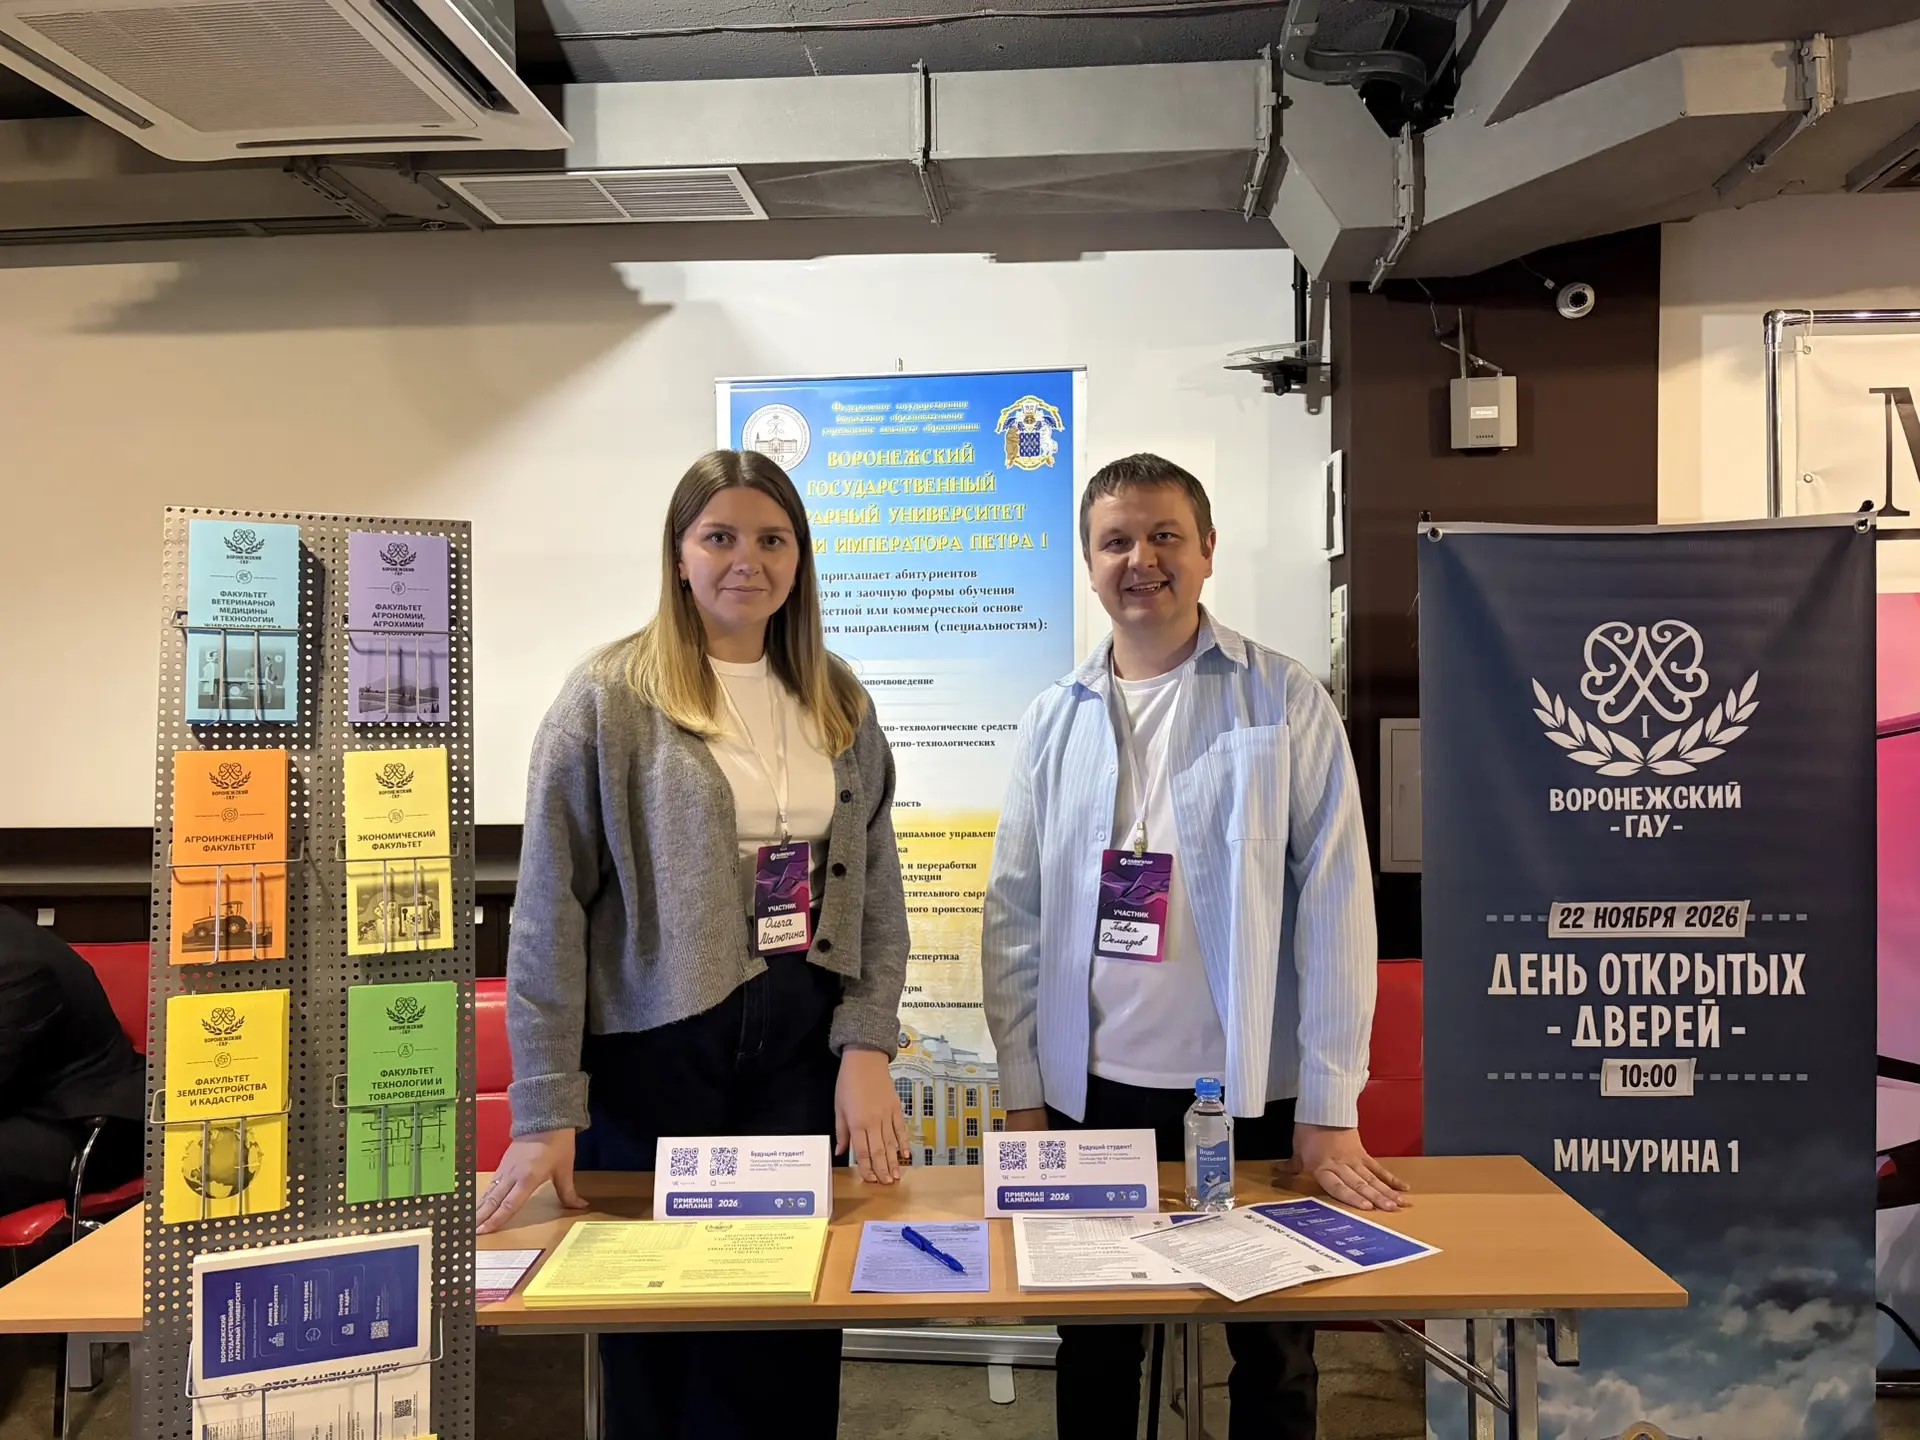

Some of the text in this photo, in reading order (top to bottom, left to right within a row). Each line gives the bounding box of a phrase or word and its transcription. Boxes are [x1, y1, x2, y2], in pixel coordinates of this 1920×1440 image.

[827, 444, 975, 468] ВОРОНЕЖСКИЙ
[807, 472, 996, 498] ГОСУДАРСТВЕННЫЙ
[888, 503, 1027, 525] УНИВЕРСИТЕТ
[835, 534, 962, 553] ИМПЕРАТОРА
[970, 533, 1034, 550] ПЕТРА
[1040, 532, 1048, 549] I
[821, 568, 977, 583] приглашает абитуриентов
[220, 590, 267, 598] ФАКУЛЬТЕТ
[845, 590, 852, 598] и
[857, 588, 907, 600] заочную
[911, 586, 955, 599] формы
[959, 585, 1015, 597] обучения
[211, 598, 276, 607] ВЕТЕРИНАРНОЙ
[375, 603, 422, 611] ФАКУЛЬТЕТ
[219, 607, 268, 615] МЕДИЦИНЫ
[866, 605, 890, 615] или
[893, 602, 979, 617] коммерческой
[983, 603, 1024, 614] основе
[220, 615, 274, 623] ТЕХНОЛОГИИ
[372, 612, 425, 620] АГРОНОМИИ,
[373, 620, 424, 629] АГРОХИМИИ
[845, 622, 929, 635] направлениям
[934, 618, 1048, 635] (специальностям):
[1549, 782, 1742, 812] ВОРОНЕЖСКИЙ
[184, 832, 274, 843] АГРОИНЖЕНЕРНЫЙ
[357, 829, 436, 842] ЭКОНОМИЧЕСКИЙ
[202, 843, 256, 852] ФАКУЛЬТЕТ
[371, 840, 422, 850] ФАКУЛЬТЕТ
[917, 861, 977, 872] переработки
[768, 903, 797, 912] УЧАСТНИК
[1113, 909, 1149, 918] УЧАСТНИК
[765, 918, 793, 929] Ольга
[1558, 905, 1739, 930] 22 НОЯБРЯ 2026
[1487, 952, 1807, 996] ДЕНЬ ОТКРЫТЫХ
[901, 1001, 984, 1010] водопользование
[1572, 998, 1721, 1049] ДВЕРЕЙ
[380, 1066, 434, 1077] ФАКУЛЬТЕТ
[1619, 1063, 1678, 1088] 10:00
[195, 1074, 250, 1086] ФАКУЛЬТЕТ
[371, 1077, 443, 1090] ТЕХНОЛОГИИ И
[176, 1082, 267, 1098] ЗЕМЛЕУСТРОЙСТВА
[368, 1088, 445, 1101] ТОВАРОВЕДЕНИЯ
[189, 1093, 255, 1107] И КАДАСТРОВ
[1553, 1138, 1740, 1174] МИЧУРИНА 1
[1050, 1193, 1070, 1201] 2026
[718, 1199, 738, 1208] 2026
